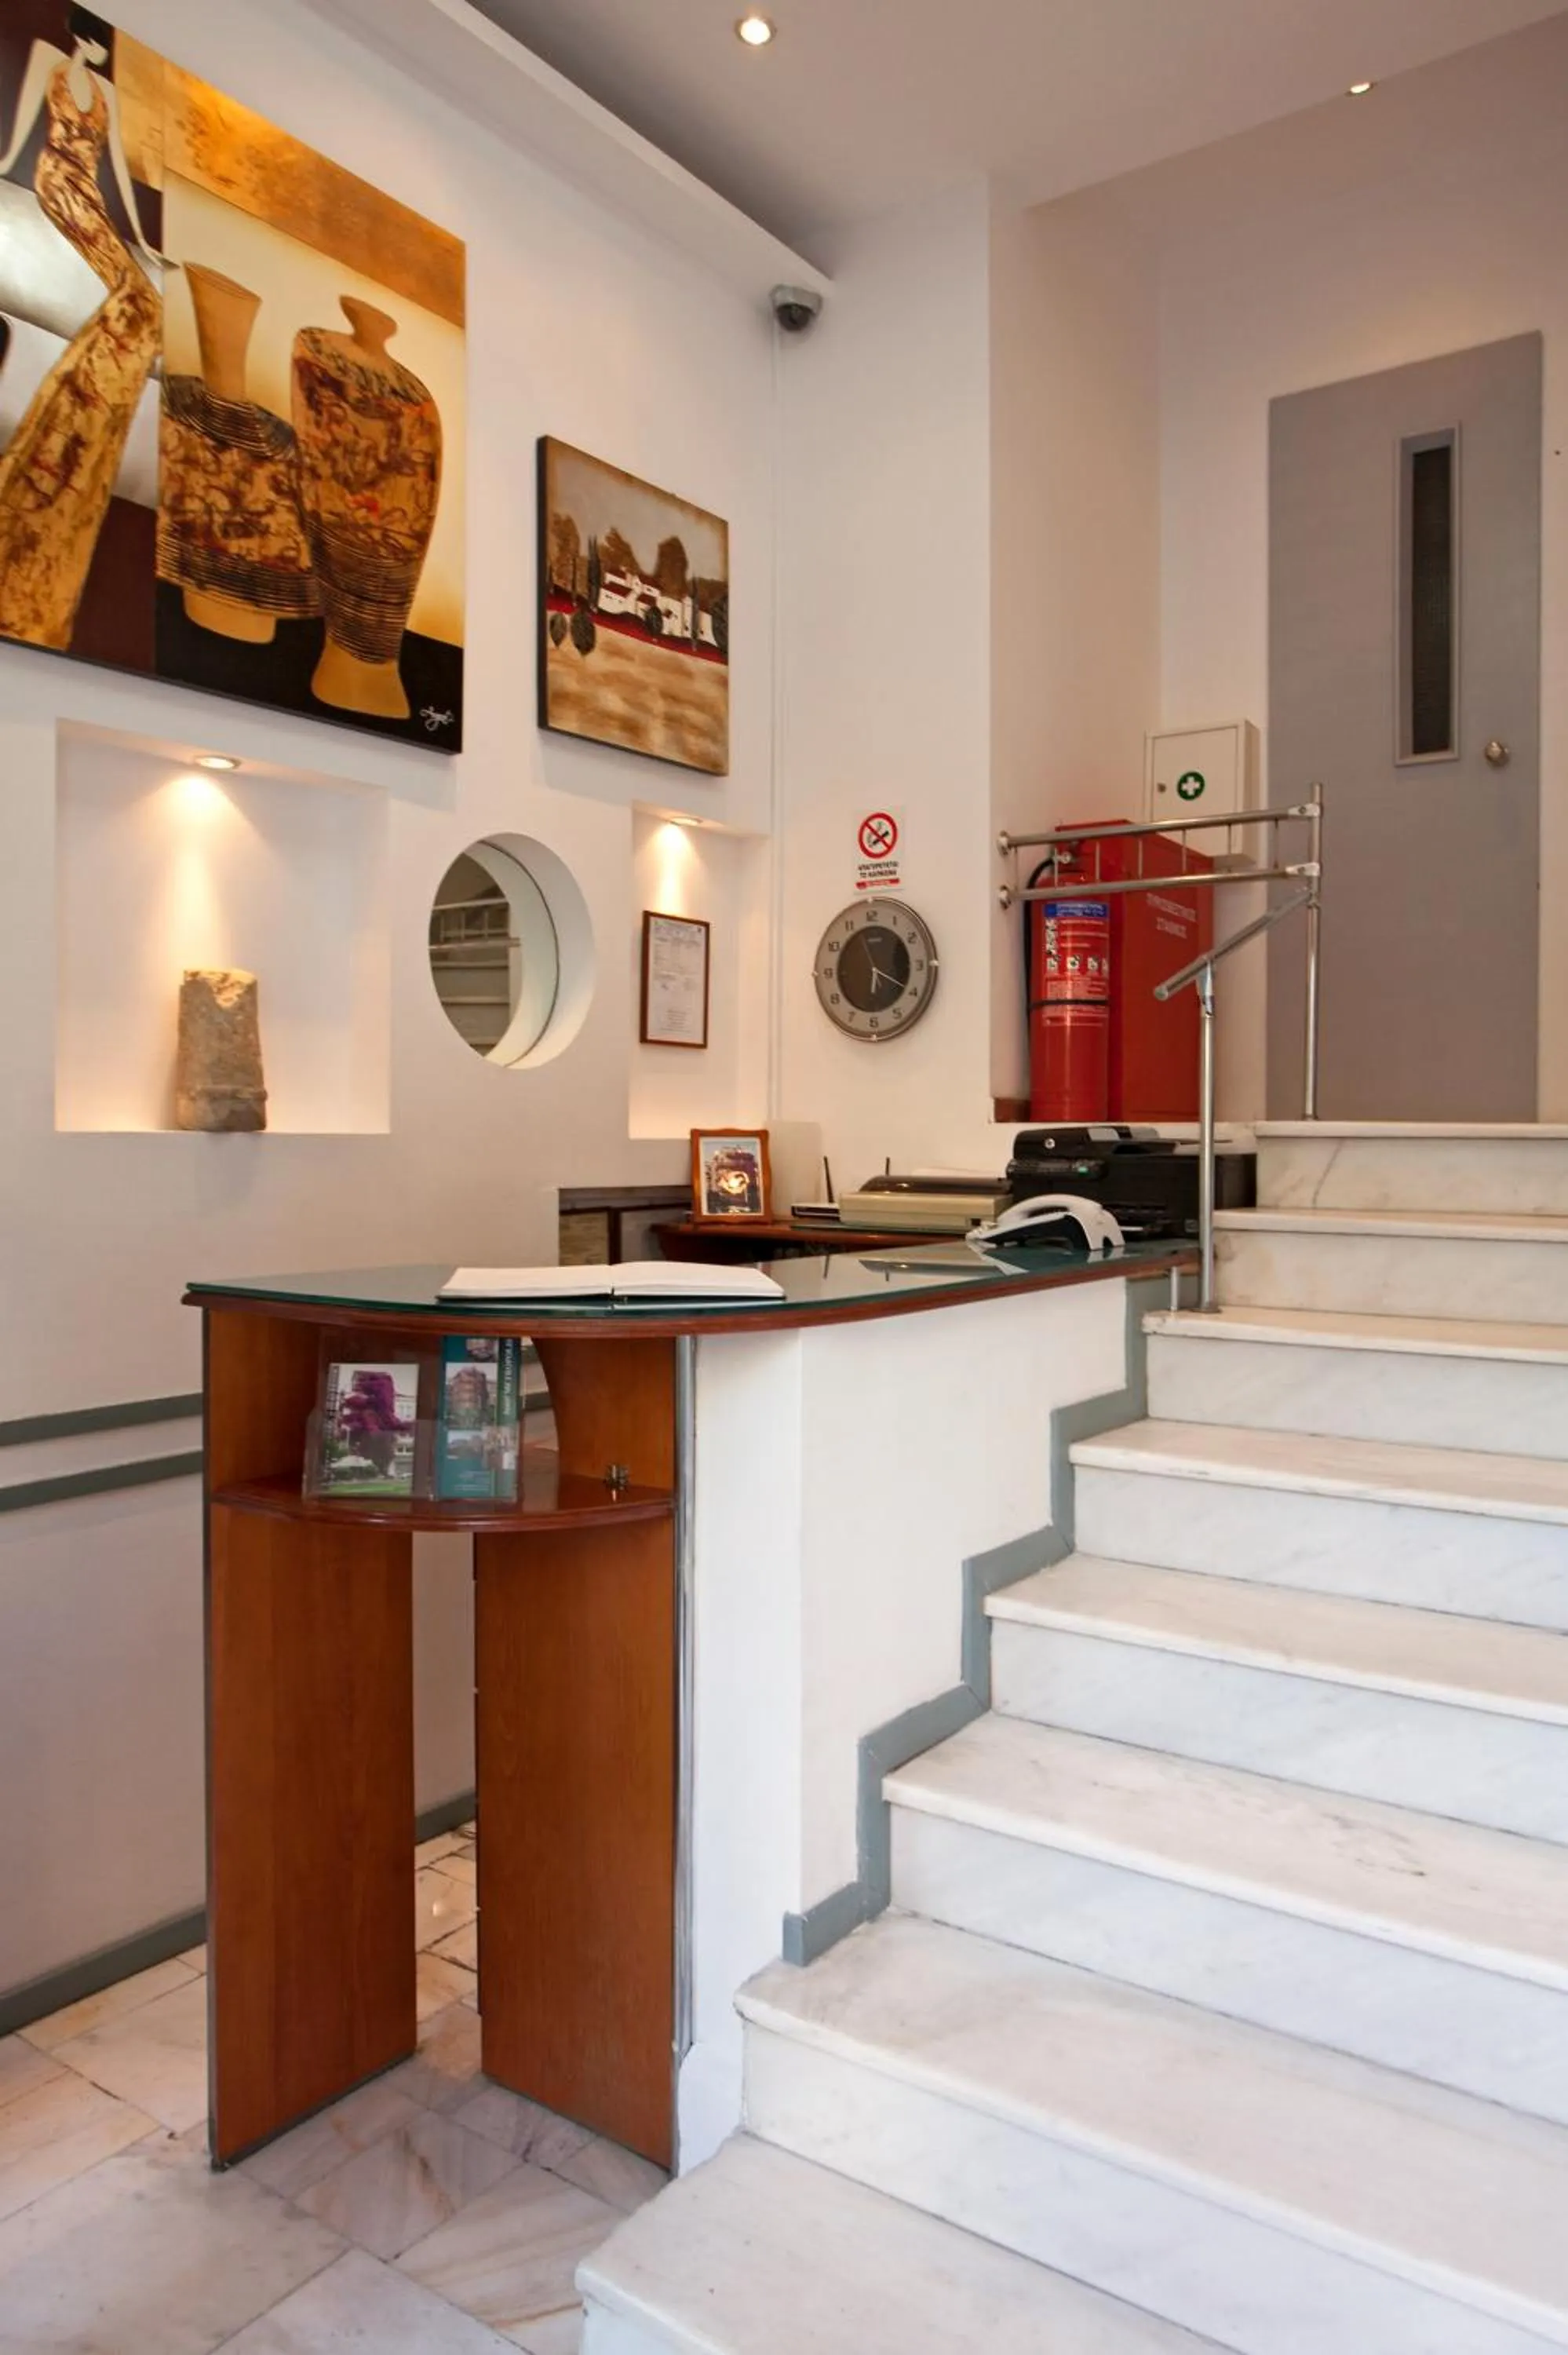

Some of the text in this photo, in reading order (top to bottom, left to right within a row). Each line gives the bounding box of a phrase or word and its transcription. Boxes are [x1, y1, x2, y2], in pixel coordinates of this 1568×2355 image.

[866, 911, 878, 922] 12
[845, 920, 854, 932] 11
[907, 932, 917, 944] 2
[828, 941, 840, 951] 10
[915, 959, 924, 971] 3
[823, 968, 833, 979] 9
[909, 987, 917, 997] 4
[830, 993, 840, 1004] 8
[848, 1010, 856, 1023] 7
[892, 1008, 903, 1020] 5
[869, 1017, 879, 1028] 6
